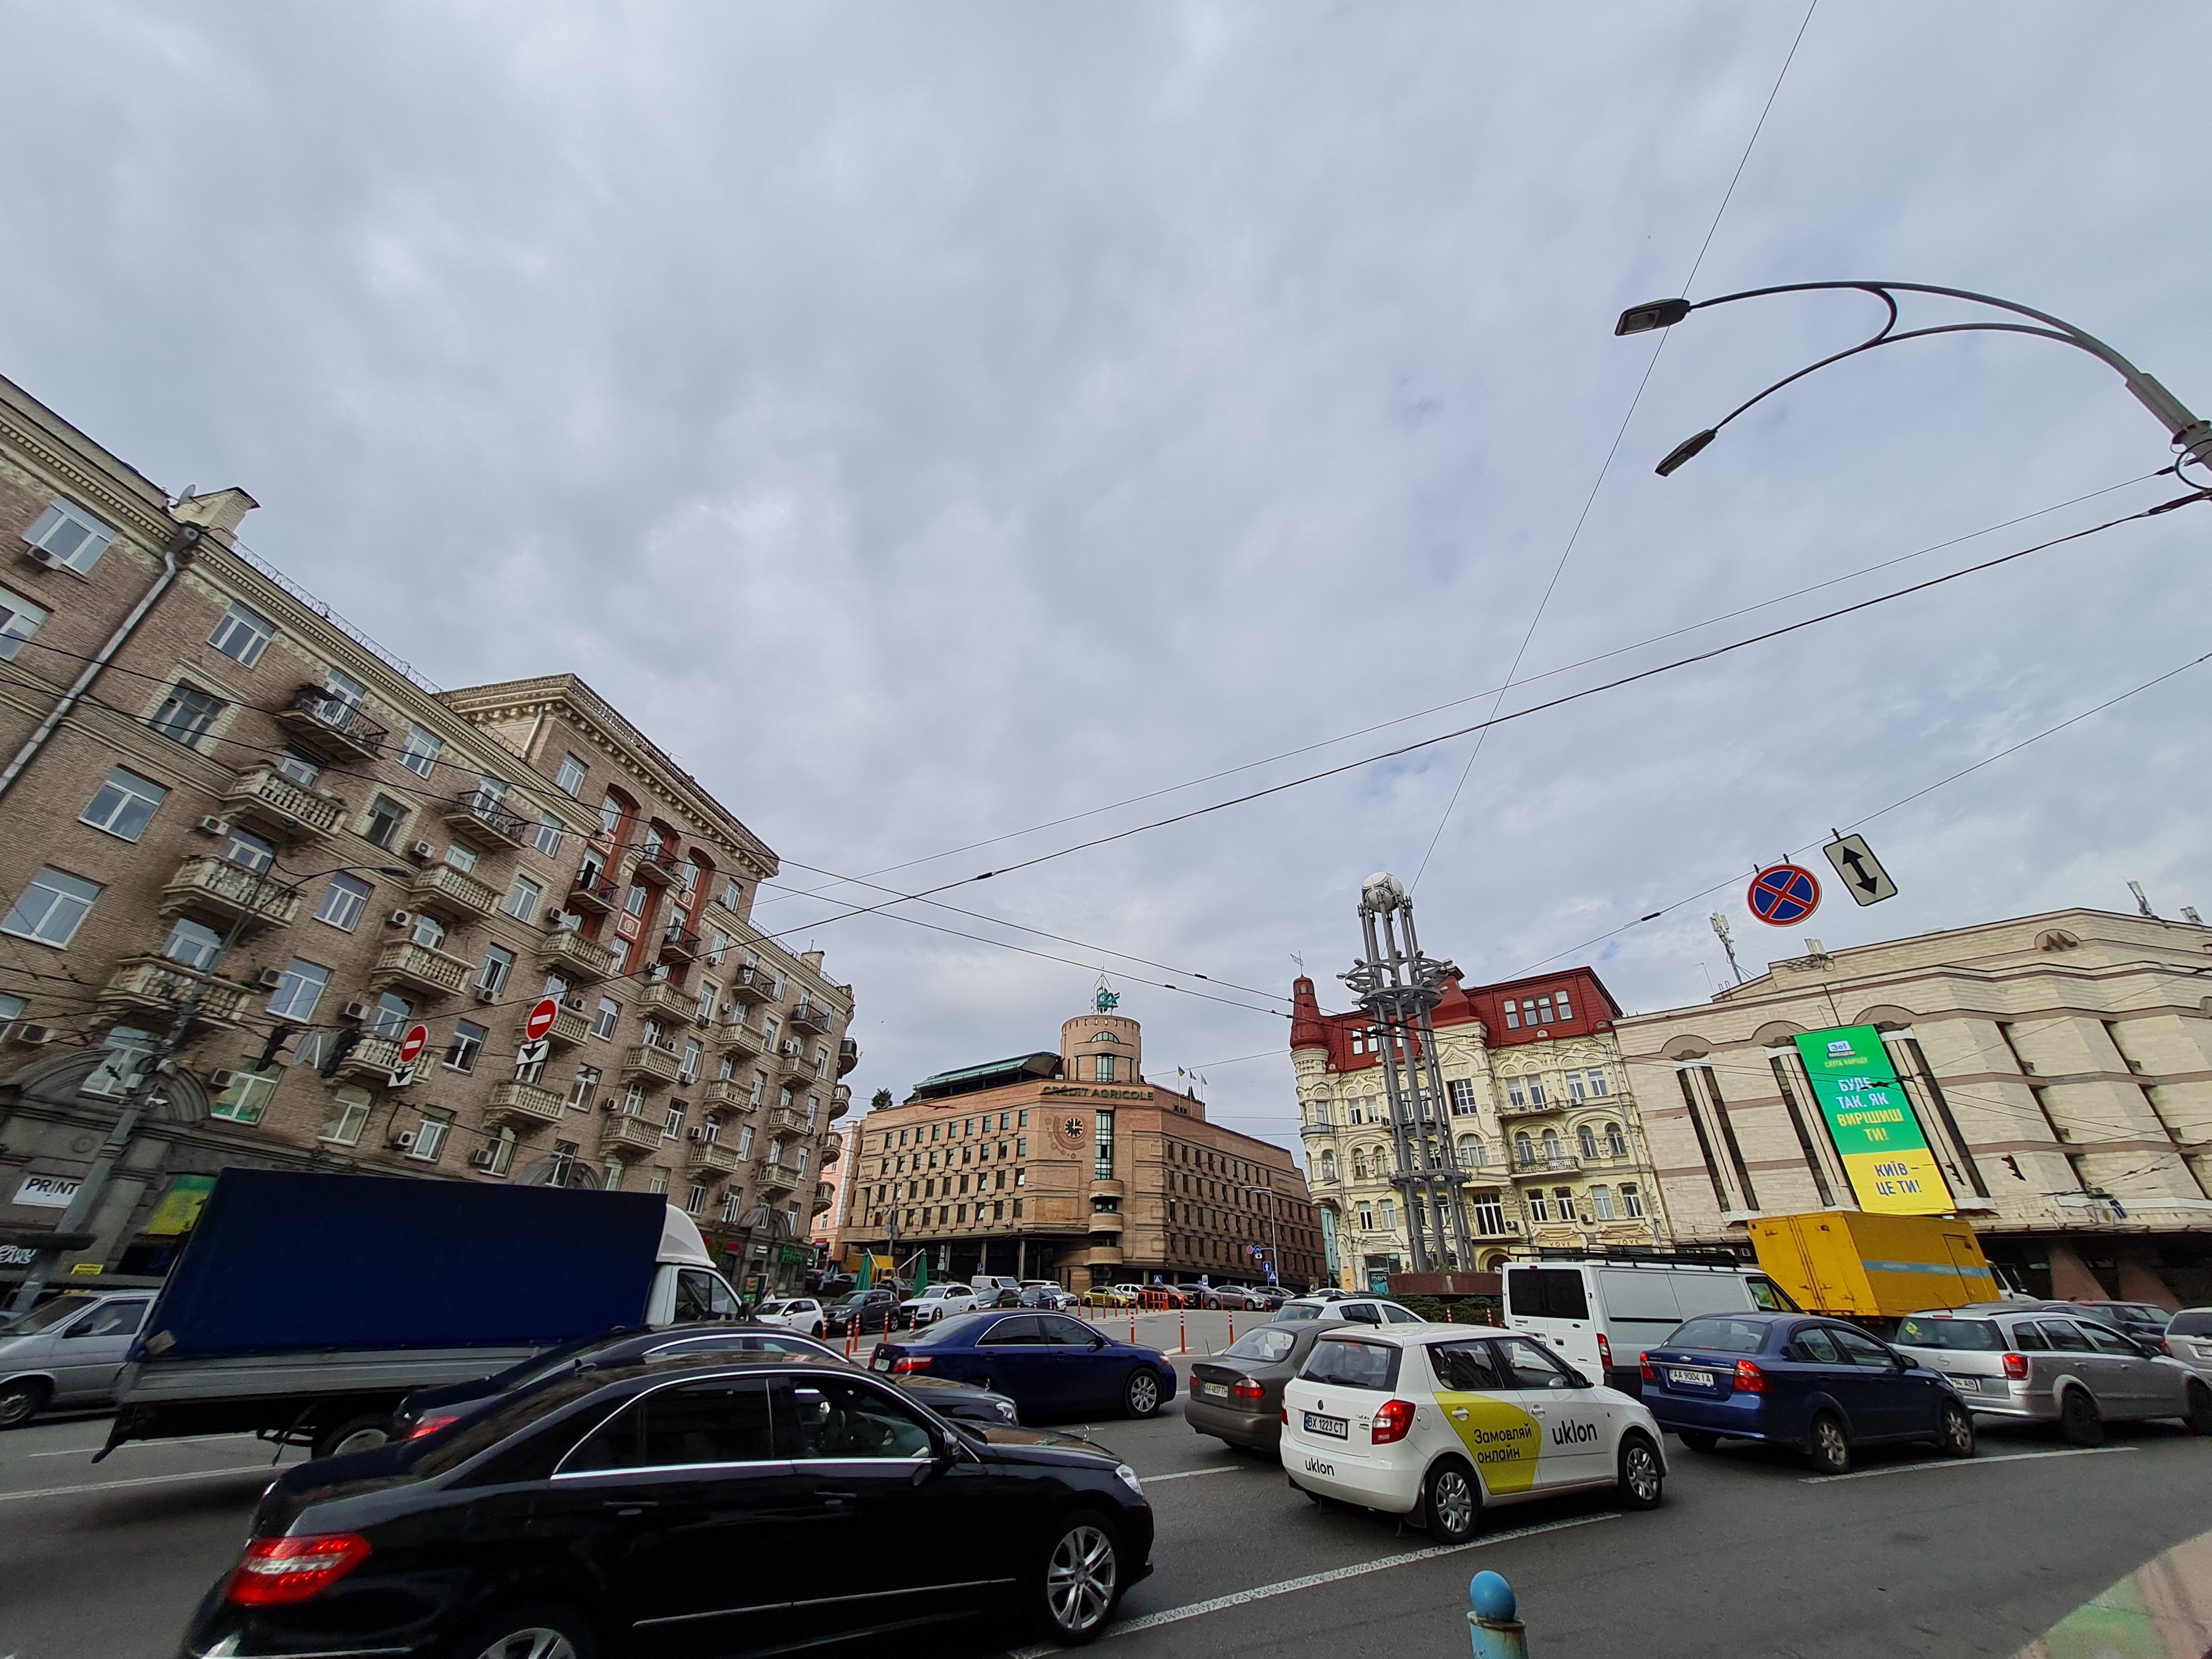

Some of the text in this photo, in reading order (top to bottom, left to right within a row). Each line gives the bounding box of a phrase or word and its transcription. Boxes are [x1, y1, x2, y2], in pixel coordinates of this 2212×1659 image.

[1091, 1088, 1154, 1101] AGRICOLE
[1869, 1092, 1889, 1105] ЯК
[1836, 1108, 1904, 1126] ВИРІШИШ
[1863, 1127, 1889, 1142] ТИ!
[1874, 1161, 1908, 1177] КИЇВ
[1875, 1180, 1922, 1196] ЦЕ ТИ!
[1674, 1370, 1711, 1383] AA 9004 IA
[1308, 1417, 1344, 1434] BX 1223 CT
[1474, 1423, 1532, 1444] Замовляй
[1552, 1419, 1598, 1445] uklon
[1477, 1444, 1520, 1463] онлайн
[1305, 1457, 1335, 1476] uklon
